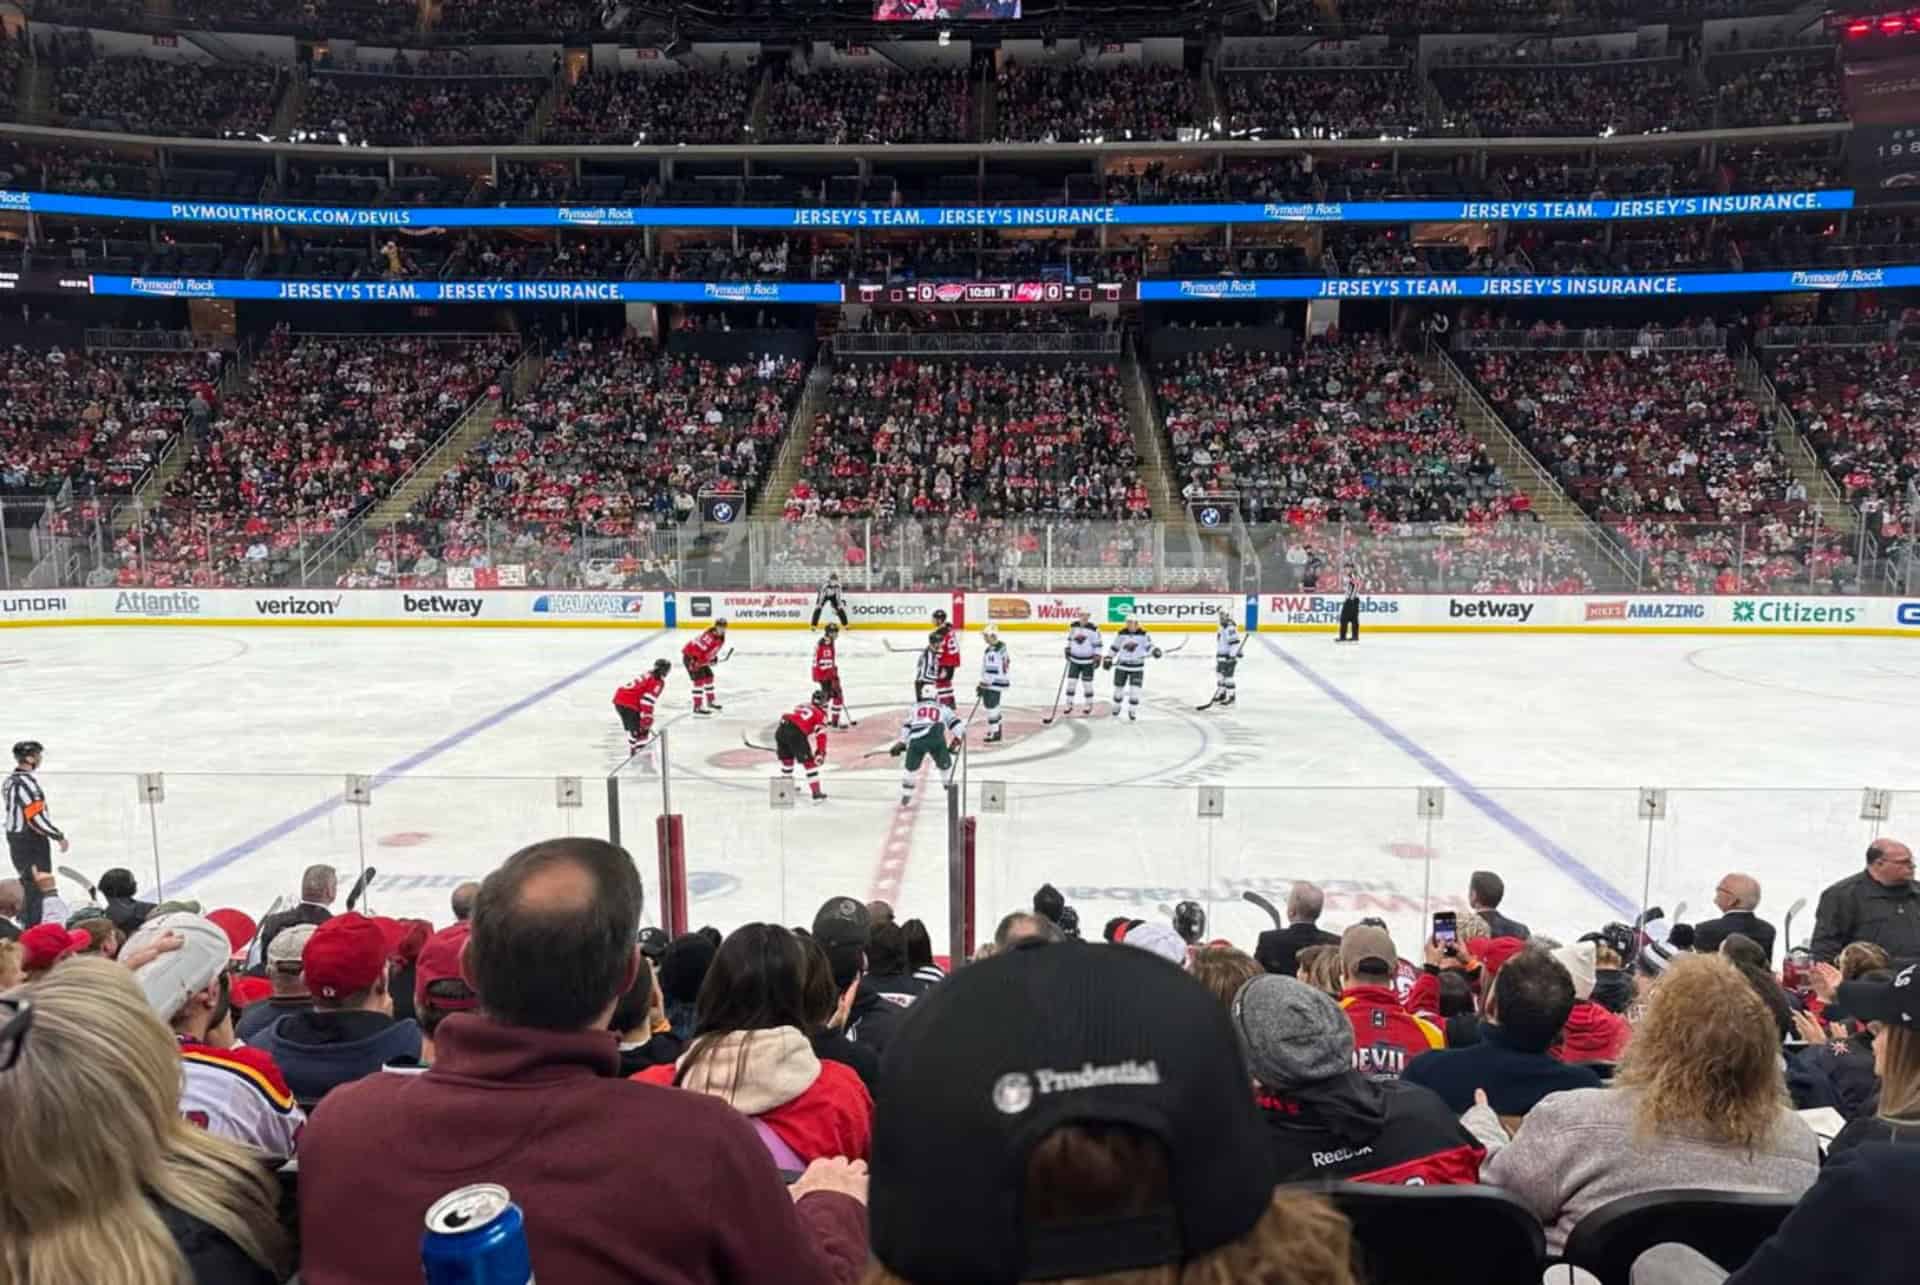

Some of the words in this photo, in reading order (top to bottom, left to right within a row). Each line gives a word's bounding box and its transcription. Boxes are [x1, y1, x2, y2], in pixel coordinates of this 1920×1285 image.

[608, 207, 633, 219] Rock
[1315, 203, 1342, 216] Rock
[1460, 203, 1537, 218] JERSEY'S
[1543, 203, 1597, 217] TEAM.
[1611, 198, 1697, 218] JERSEY'S
[1701, 193, 1822, 212] INSURANCE.
[172, 204, 410, 225] PLYMOUTHROCK.COM/DEVILS
[793, 210, 867, 225] JERSEY'S
[872, 210, 925, 225] TEAM.
[938, 209, 1012, 224] JERSEY'S
[1017, 208, 1119, 223] INSURANCE.
[131, 277, 184, 292] Plymouth
[186, 279, 214, 290] Rock
[1230, 280, 1256, 292] Rock
[1791, 270, 1849, 286] Plymouth
[1851, 269, 1884, 282] Rock
[279, 283, 361, 299] JERSEY'S
[366, 284, 419, 299] TEAM.
[437, 283, 514, 299] JERSEY'S
[519, 284, 624, 300] INSURANCE.
[753, 283, 778, 296] Rock
[1319, 280, 1399, 296] JERSEY'S
[1406, 279, 1462, 295] TEAM.
[1480, 279, 1562, 295] JERSEY'S
[1567, 278, 1682, 294] INSURANCE.
[115, 592, 200, 613] Atlantic
[255, 596, 334, 615] verizon
[403, 594, 483, 616] betway
[1272, 596, 1399, 613] RWJBarabas
[1450, 599, 1534, 621] betway
[1627, 603, 1704, 618] AMAZING
[1288, 613, 1340, 623] HEALTH
[1760, 601, 1855, 623] Citizens
[1034, 1060, 1160, 1093] Prudential
